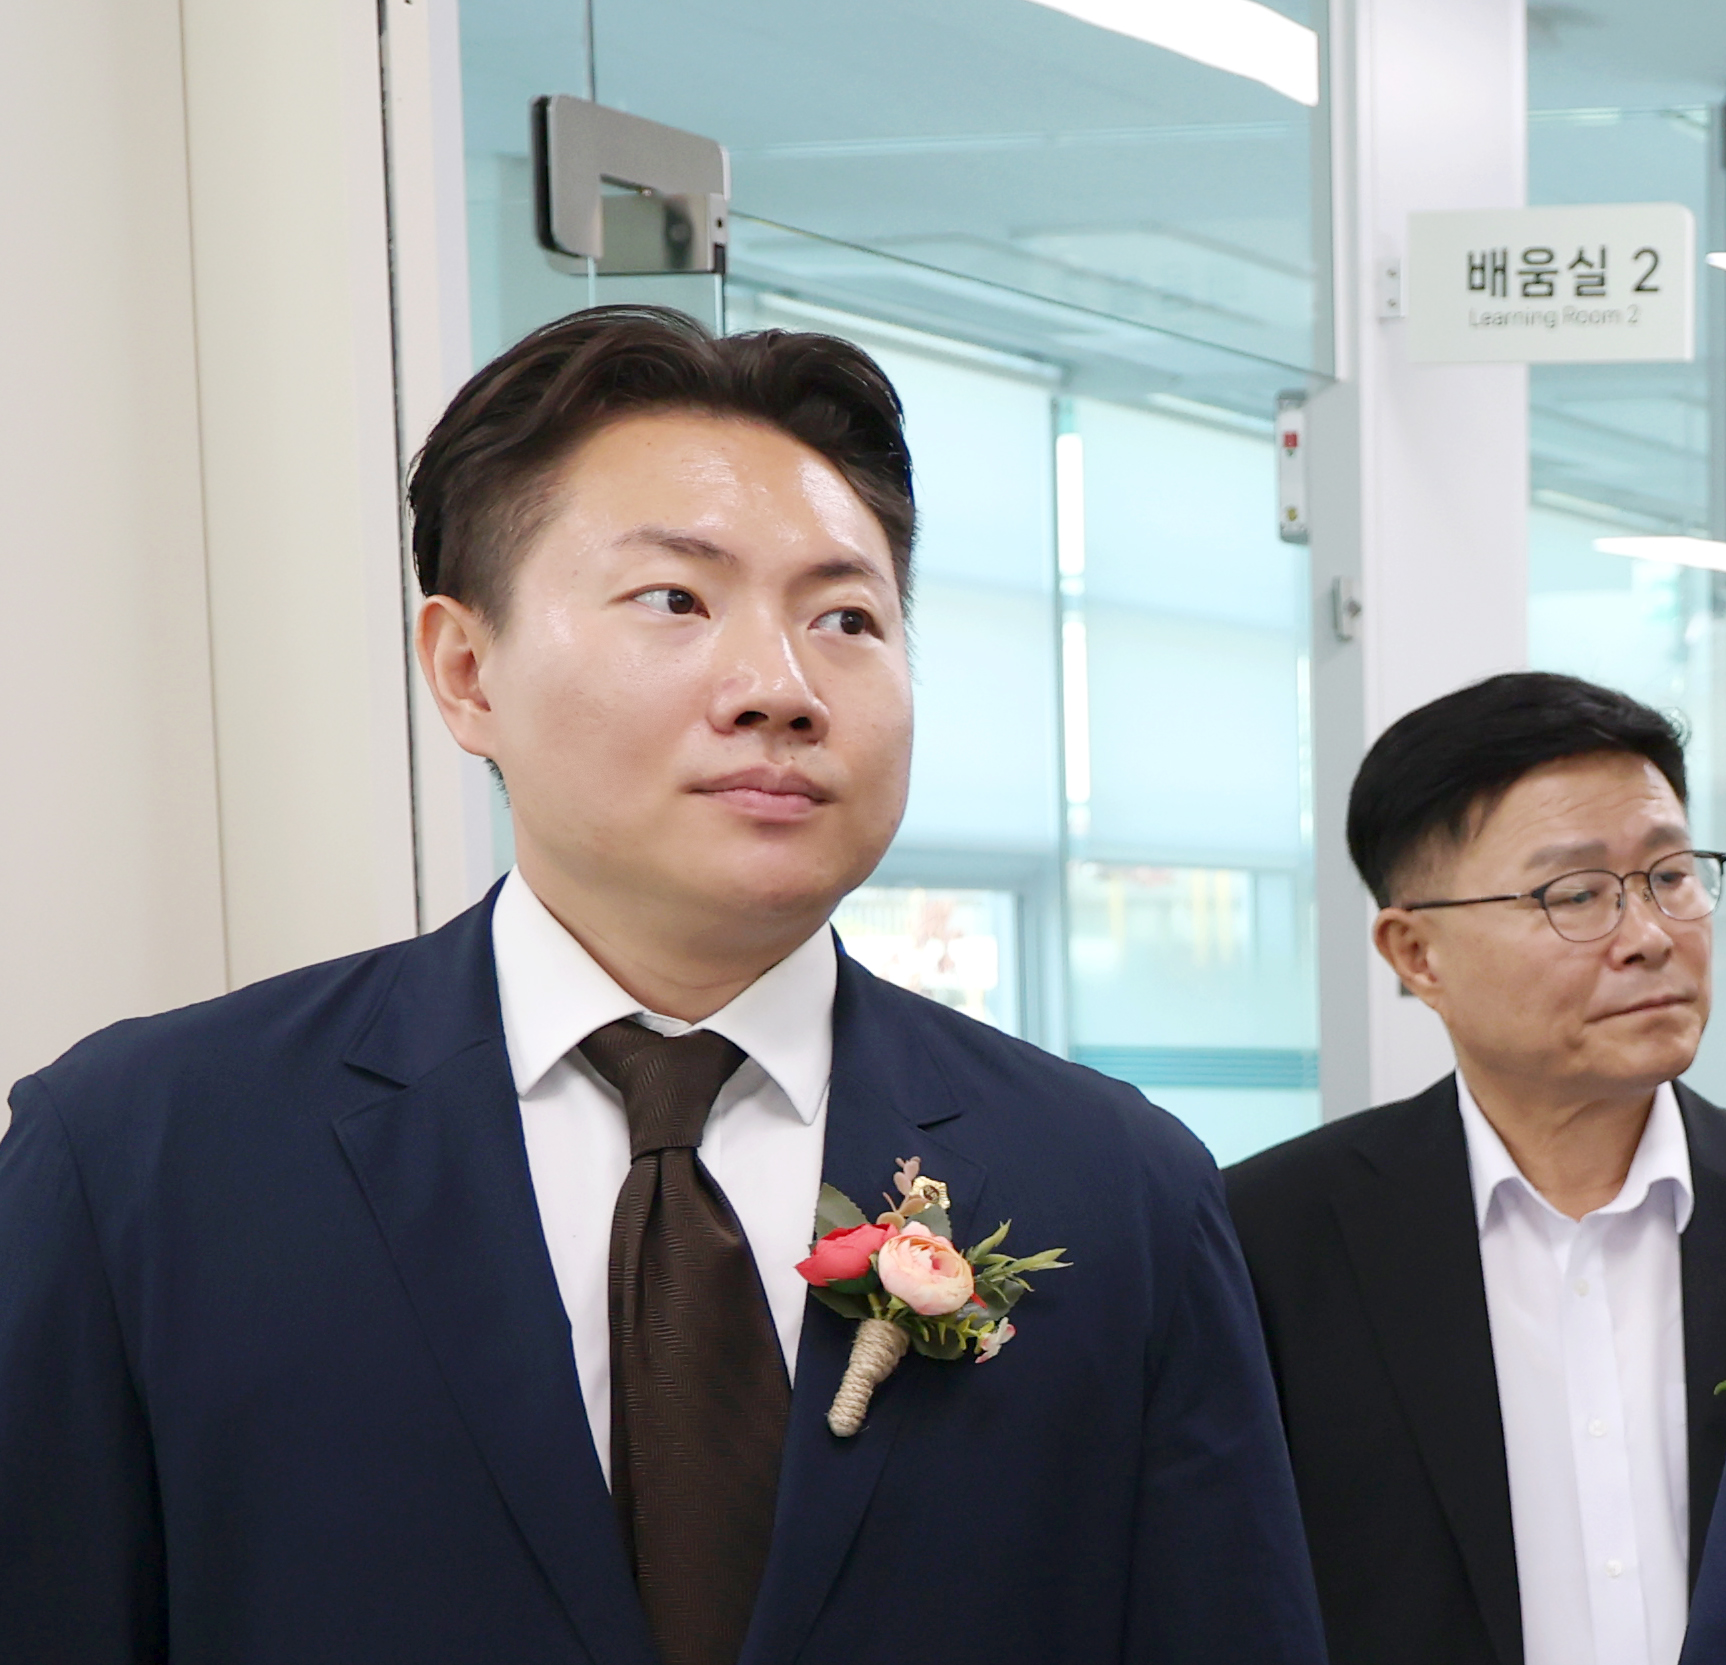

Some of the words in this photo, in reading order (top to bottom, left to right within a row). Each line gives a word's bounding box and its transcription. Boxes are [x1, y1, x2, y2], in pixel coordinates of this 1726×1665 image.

[1466, 245, 1607, 298] 배움실
[1631, 248, 1660, 293] 2
[1469, 306, 1556, 329] Learning
[1562, 304, 1621, 325] Room
[1626, 303, 1639, 324] 2
